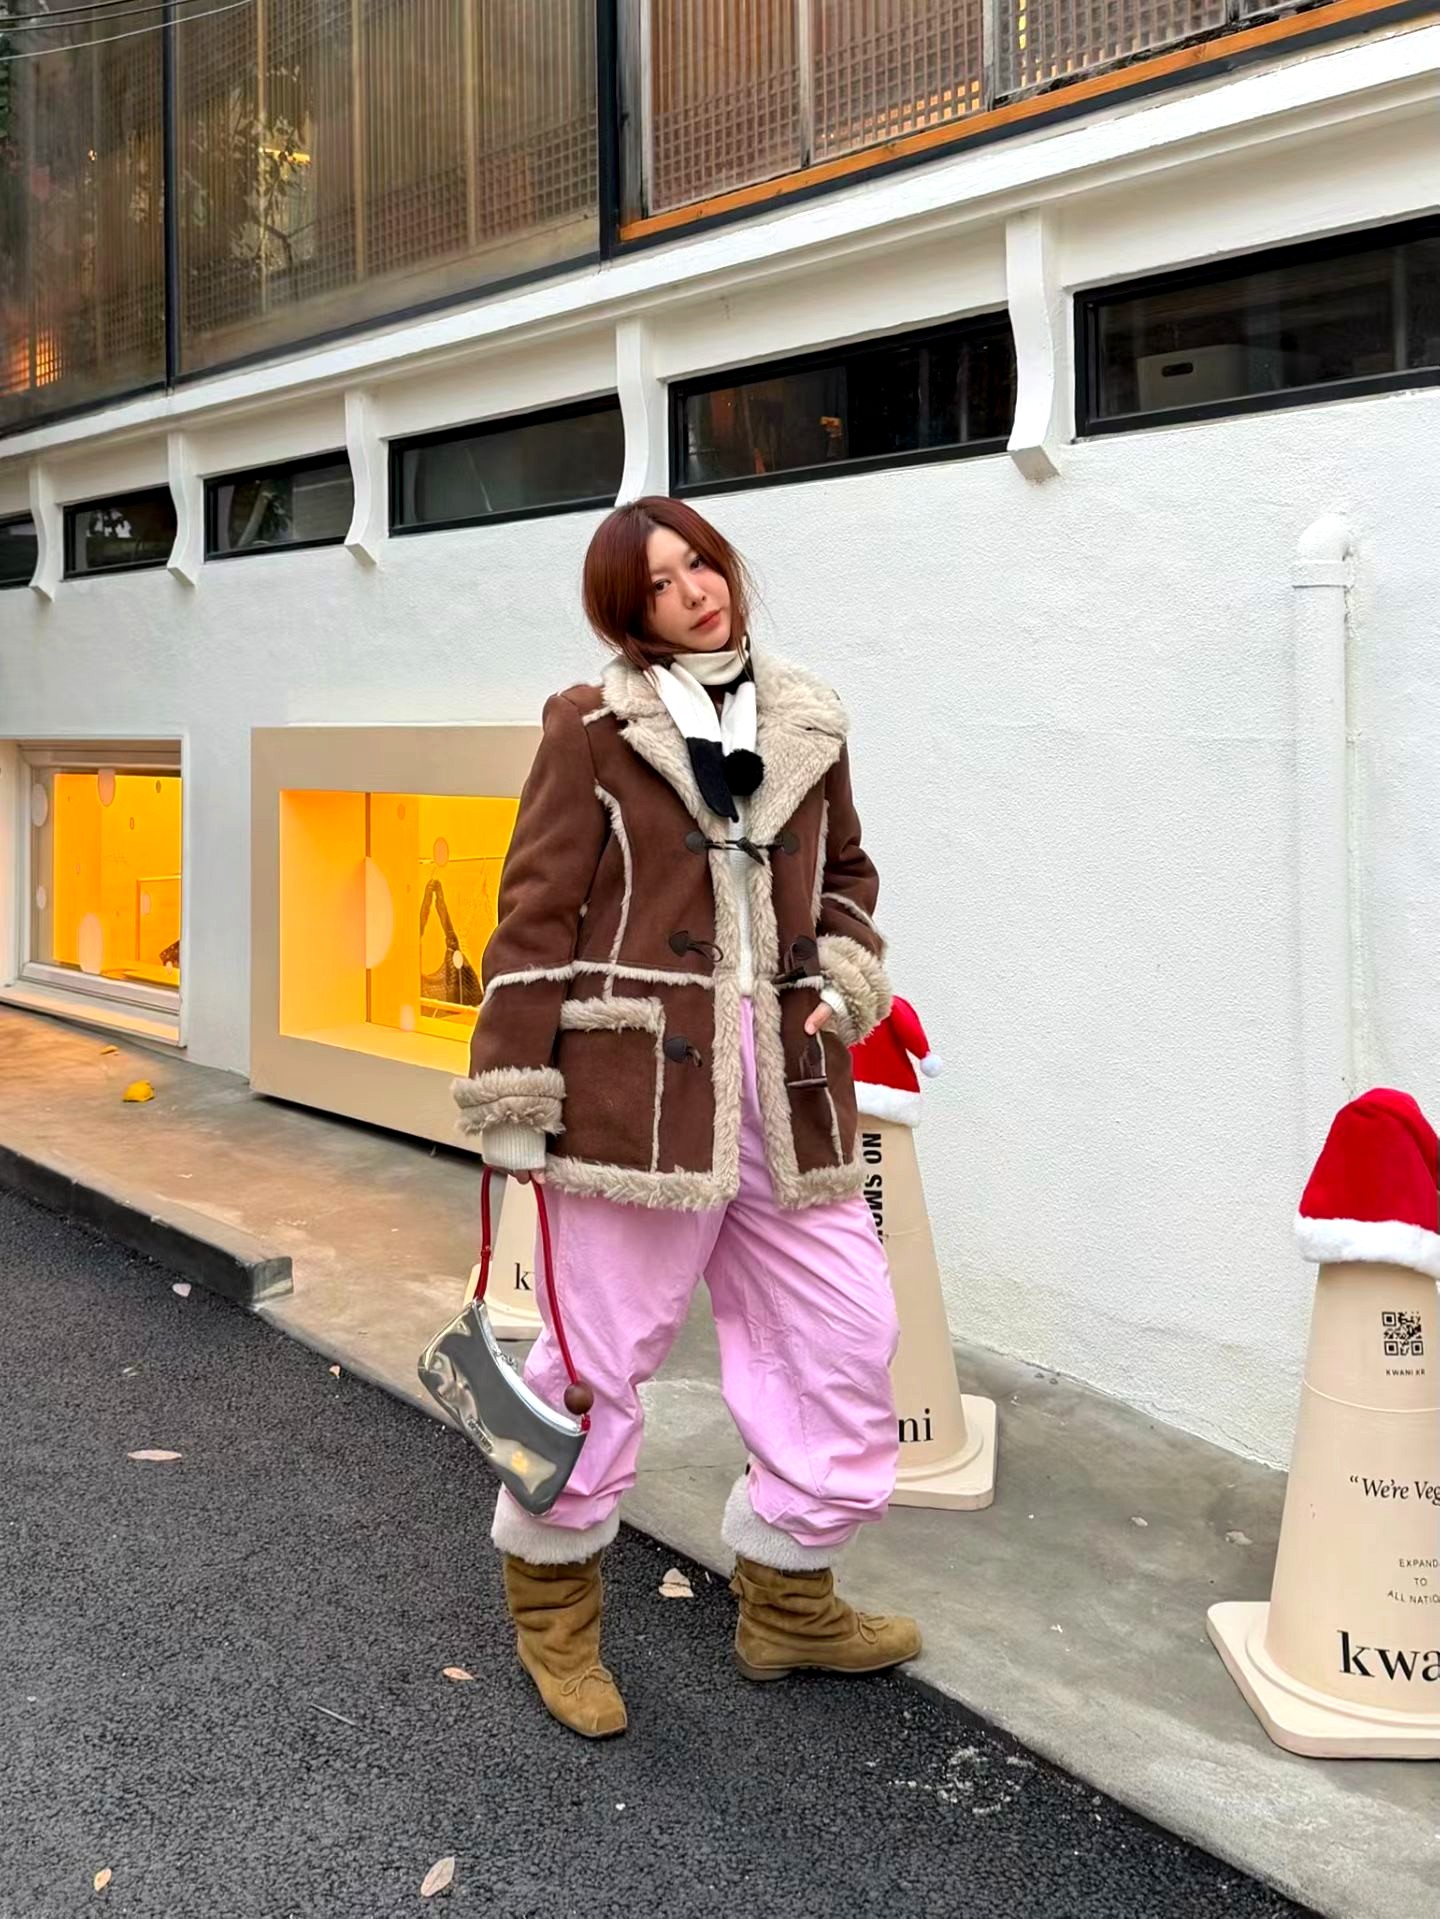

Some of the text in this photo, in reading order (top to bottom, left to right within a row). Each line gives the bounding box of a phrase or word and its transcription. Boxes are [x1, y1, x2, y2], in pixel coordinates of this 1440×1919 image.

[862, 1133, 882, 1164] NO
[1414, 1577, 1428, 1587] TO
[1387, 1590, 1404, 1602] ALL
